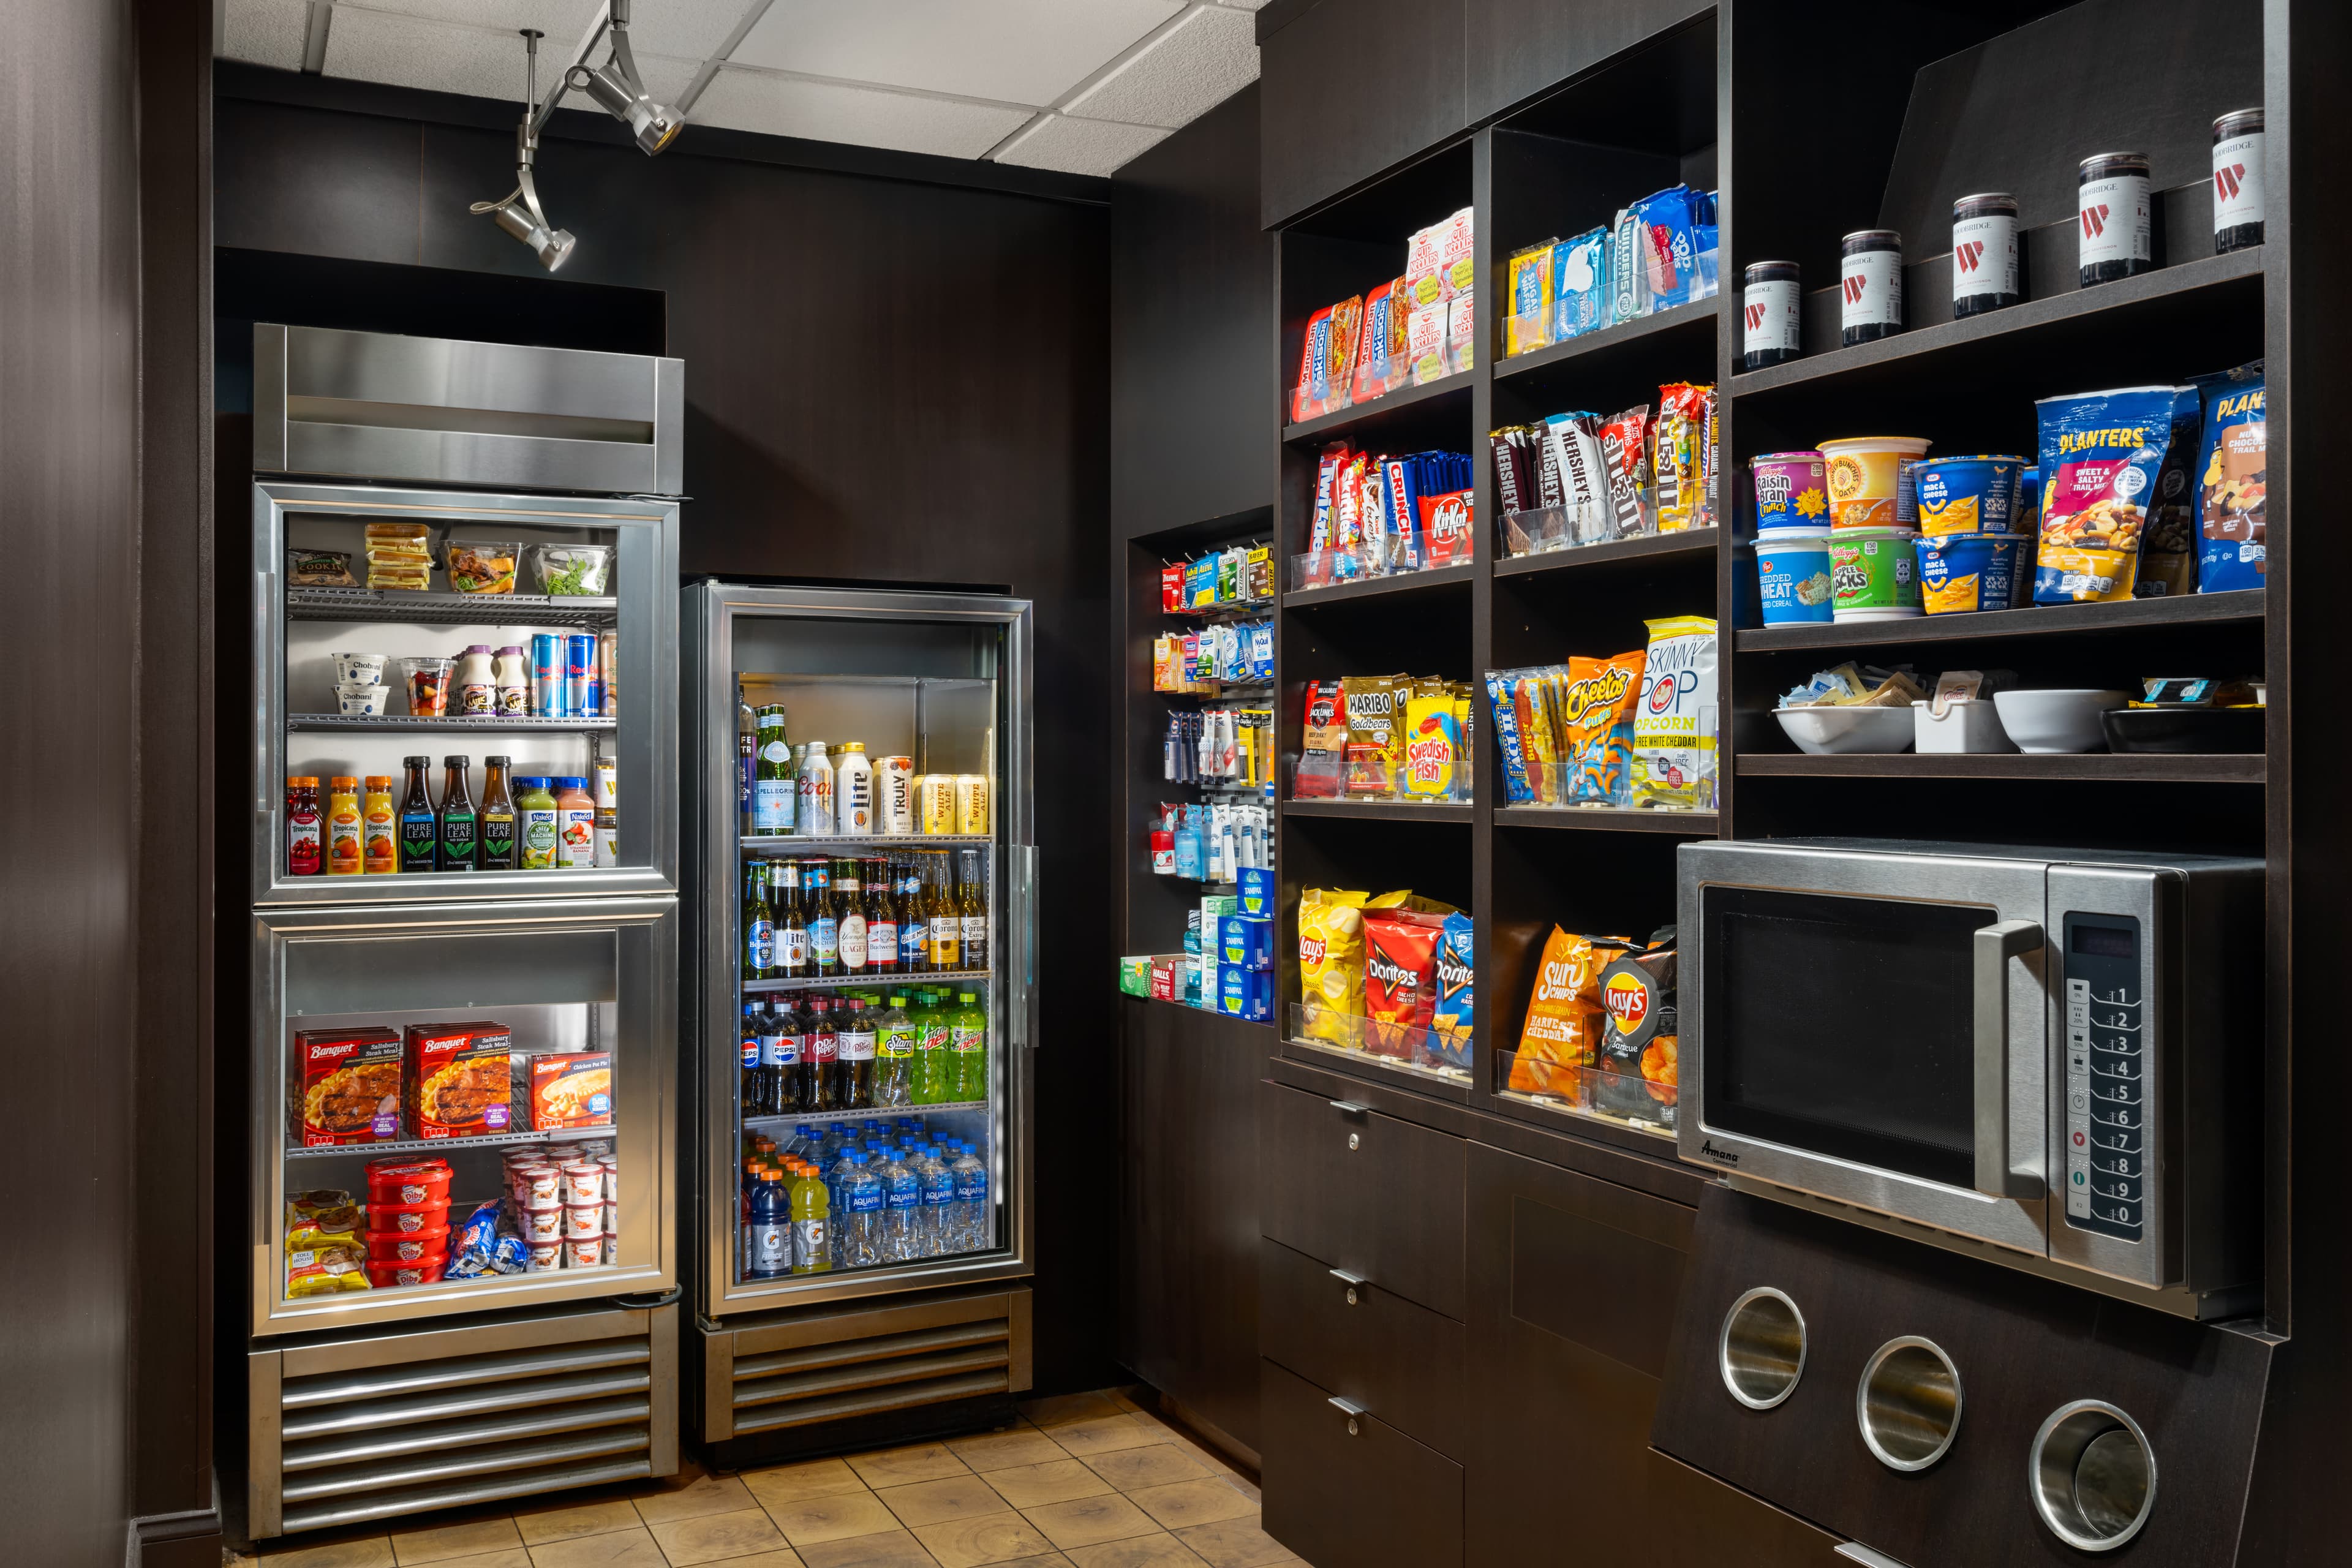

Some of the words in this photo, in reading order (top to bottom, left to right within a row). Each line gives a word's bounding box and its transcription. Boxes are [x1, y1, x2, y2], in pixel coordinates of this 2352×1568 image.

[1452, 225, 1468, 240] CUP
[1416, 244, 1431, 258] CUP
[1621, 223, 1631, 291] BUILDERS
[1410, 252, 1438, 274] NOODLES
[1521, 275, 1531, 318] WAFERS
[1529, 273, 1539, 317] SUGAR
[1362, 305, 1375, 365] Maruchan
[1419, 322, 1434, 336] CUP
[1302, 325, 1316, 383] Maruchan
[2060, 428, 2144, 454] PLANTERS
[1542, 435, 1559, 508] HERSHEY'S
[1562, 430, 1591, 504] HERSHEY'S
[1759, 466, 1784, 476] Kellogg's
[1838, 460, 1859, 483] BUNCHES
[2076, 468, 2102, 477] SWEET
[1496, 443, 1520, 516] HERSHEY'S
[1757, 476, 1790, 490] Raisin
[1760, 489, 1786, 503] Bran
[1839, 485, 1856, 497] OATS
[1339, 468, 1354, 545] Skittles
[1391, 464, 1411, 540] CRUNCH
[1760, 502, 1787, 516] Crunch
[1249, 551, 1263, 560] BAYER
[1833, 547, 1858, 558] Kellogg's
[1199, 564, 1213, 574] ALEVE
[1834, 566, 1855, 577] APPLE
[1833, 573, 1866, 605] JACKS
[1255, 637, 1268, 647] NyQuil
[1650, 641, 1705, 674] SKINNY
[353, 662, 380, 670] Chobani
[570, 665, 586, 674] Red
[1567, 668, 1629, 720] Cheetos
[1640, 671, 1698, 715] POP
[1349, 693, 1391, 715] HARIBO
[1585, 708, 1612, 730] Puffs
[1522, 722, 1536, 761] Butter
[1649, 736, 1665, 747] WHITE
[1667, 736, 1696, 747] CHEDDAR
[1409, 739, 1450, 766] Swedish
[1506, 735, 1521, 769] ACT
[1415, 760, 1439, 781] Fish
[1669, 776, 1681, 785] FREE
[851, 772, 870, 809] Lite
[894, 775, 905, 817] TRULY
[786, 933, 804, 946] Lite
[902, 933, 916, 944] BLUE
[1300, 937, 1325, 965] Lay's
[1153, 970, 1169, 980] HALLS
[1370, 958, 1418, 987] Doritos
[1539, 961, 1583, 1001] Sun
[1550, 987, 1578, 1001] CHIPS
[2119, 988, 2126, 1003] 1
[1608, 988, 1645, 1021] Lay's
[1530, 1016, 1576, 1032] HARVEST
[2119, 1012, 2128, 1027] 2
[1527, 1027, 1572, 1042] CHEDDAR
[424, 1037, 467, 1053] Banquet
[816, 1042, 837, 1054] Pepper
[823, 1039, 832, 1047] Dr
[2119, 1037, 2128, 1051] 3
[310, 1044, 355, 1059] Banquet
[537, 1061, 567, 1073] Banquet
[2119, 1062, 2128, 1076] 4
[2119, 1085, 2128, 1100] 5
[2119, 1110, 2128, 1125] 6
[2119, 1134, 2128, 1148] 7
[1702, 1140, 1738, 1162] Amana
[2119, 1158, 2128, 1173] 8
[889, 1193, 916, 1202] AQUAFINA
[925, 1189, 952, 1200] AQUAFINA
[958, 1186, 985, 1196] AQUAFINA
[2119, 1183, 2128, 1197] 9
[2119, 1207, 2128, 1221] 0
[402, 1221, 420, 1229] Dibs
[763, 1230, 780, 1250] G
[806, 1222, 823, 1244] G
[401, 1249, 419, 1257] Dibs
[401, 1276, 418, 1285] Dibs
